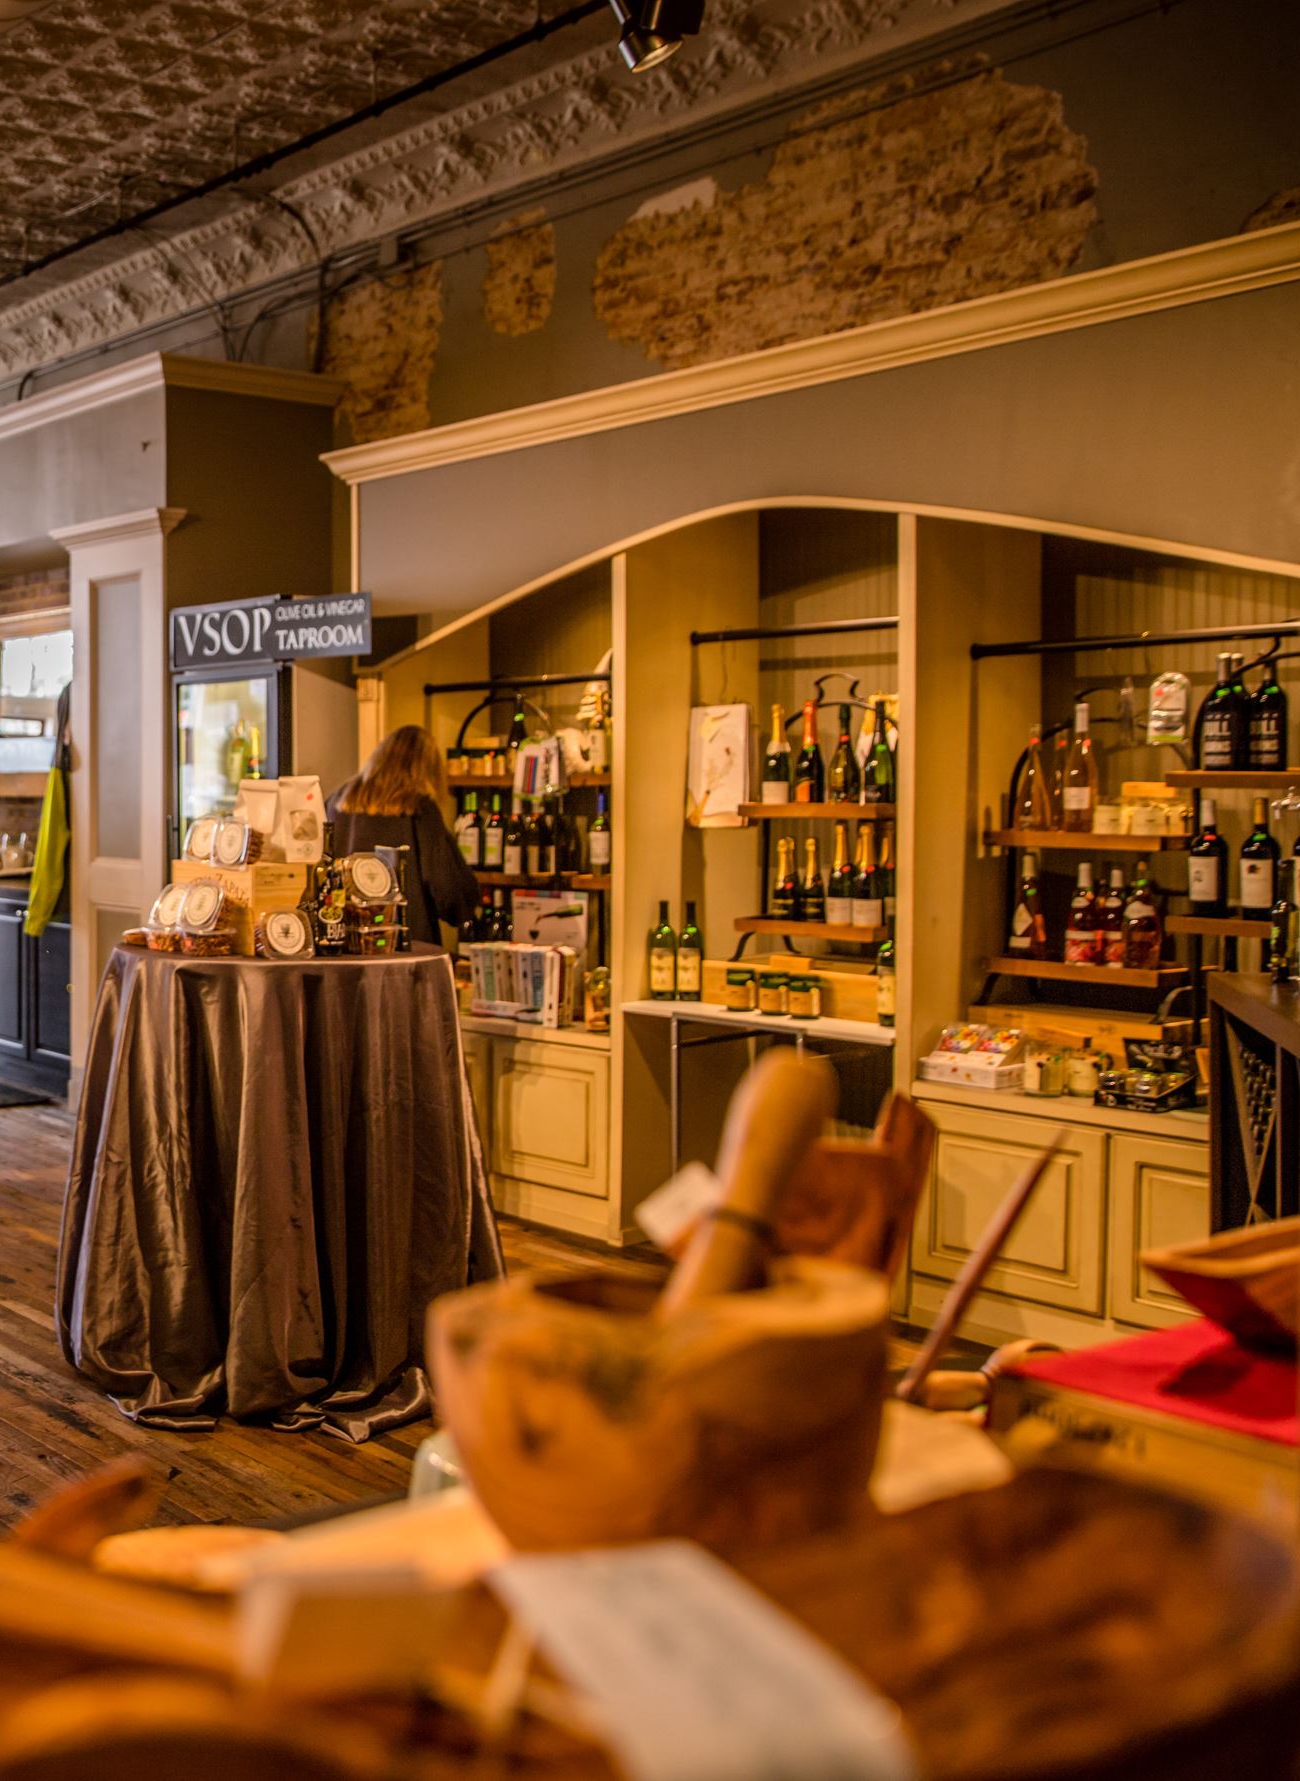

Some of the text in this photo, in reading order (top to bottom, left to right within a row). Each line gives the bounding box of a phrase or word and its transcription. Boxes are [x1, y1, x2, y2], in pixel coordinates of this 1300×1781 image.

[275, 598, 365, 621] OLIVE OIL & VINEGAR
[178, 607, 272, 657] VSOP
[275, 624, 364, 650] TAPROOM
